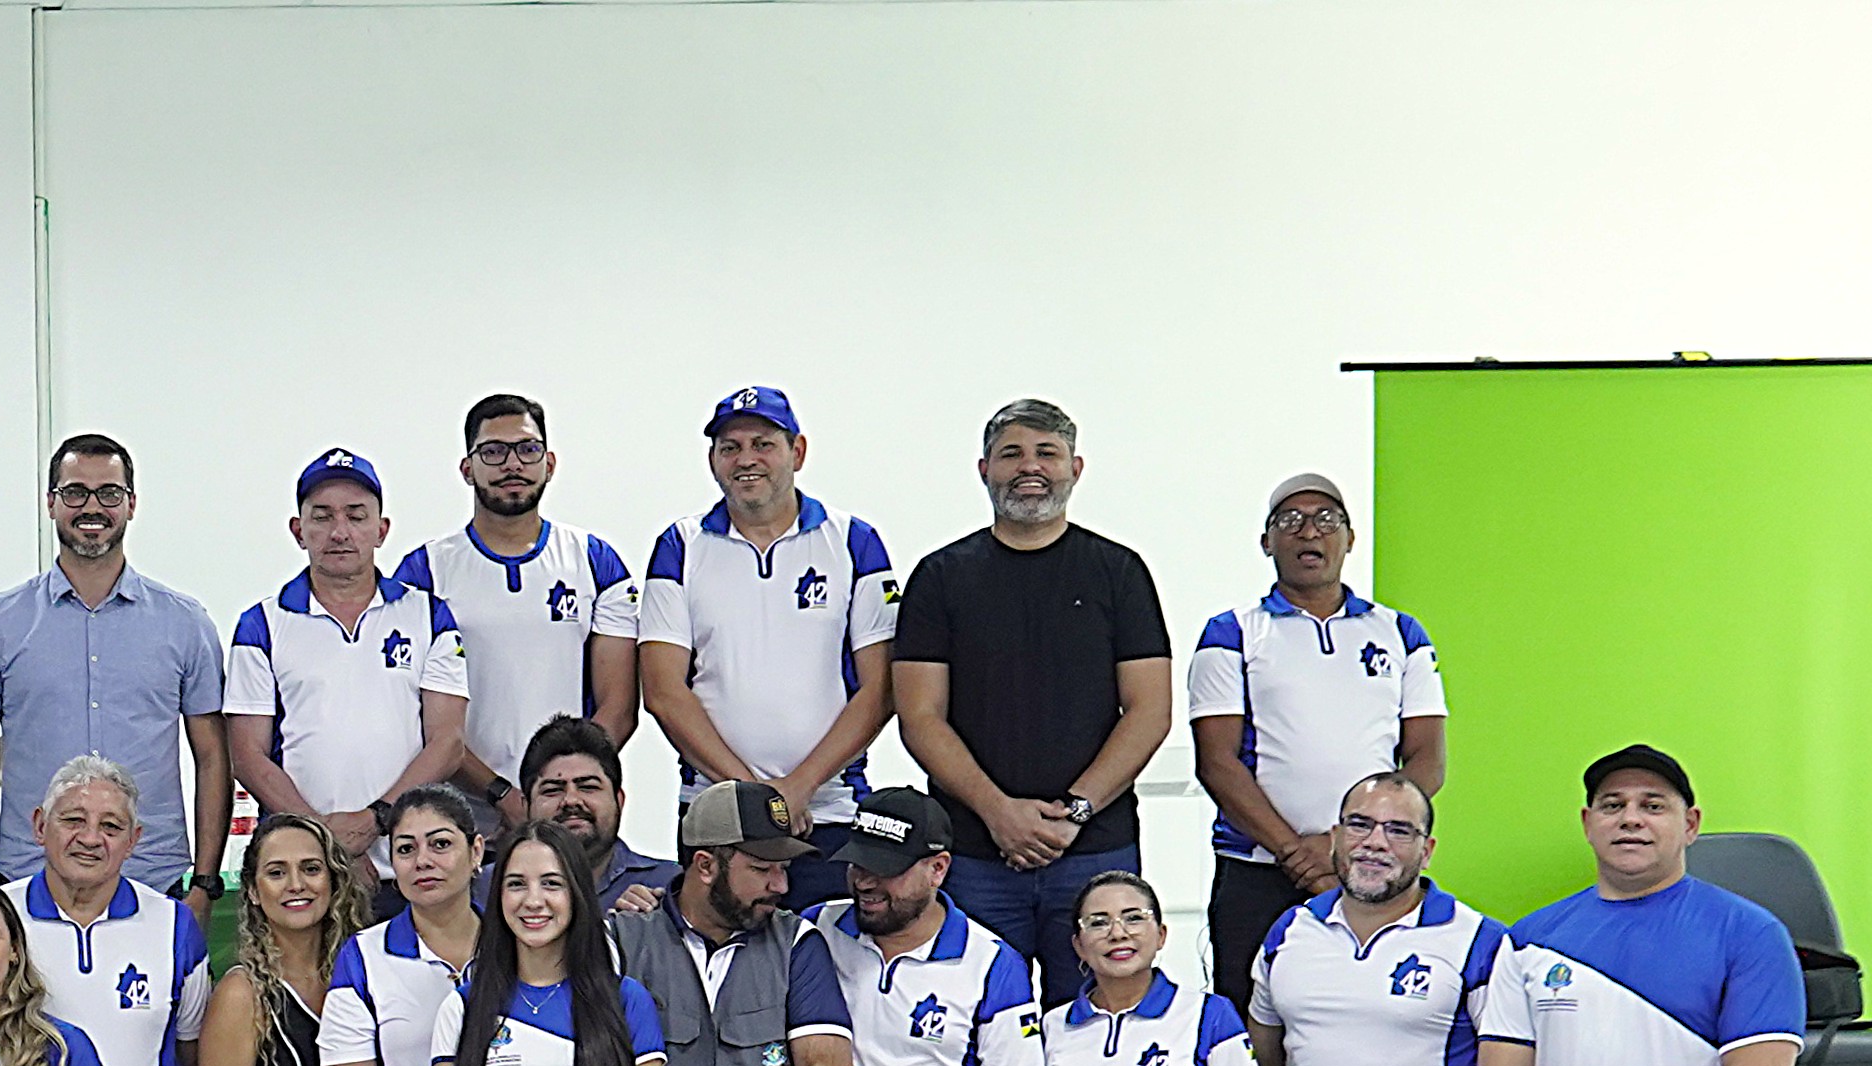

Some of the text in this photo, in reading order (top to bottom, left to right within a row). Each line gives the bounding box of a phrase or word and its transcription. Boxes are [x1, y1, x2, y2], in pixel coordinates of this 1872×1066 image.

[804, 582, 826, 606] 42
[557, 595, 578, 619] 42
[391, 644, 411, 667] 42
[1370, 654, 1390, 676] 42
[127, 981, 148, 1006] 42
[1400, 970, 1428, 997] 42
[919, 1011, 945, 1037] 42
